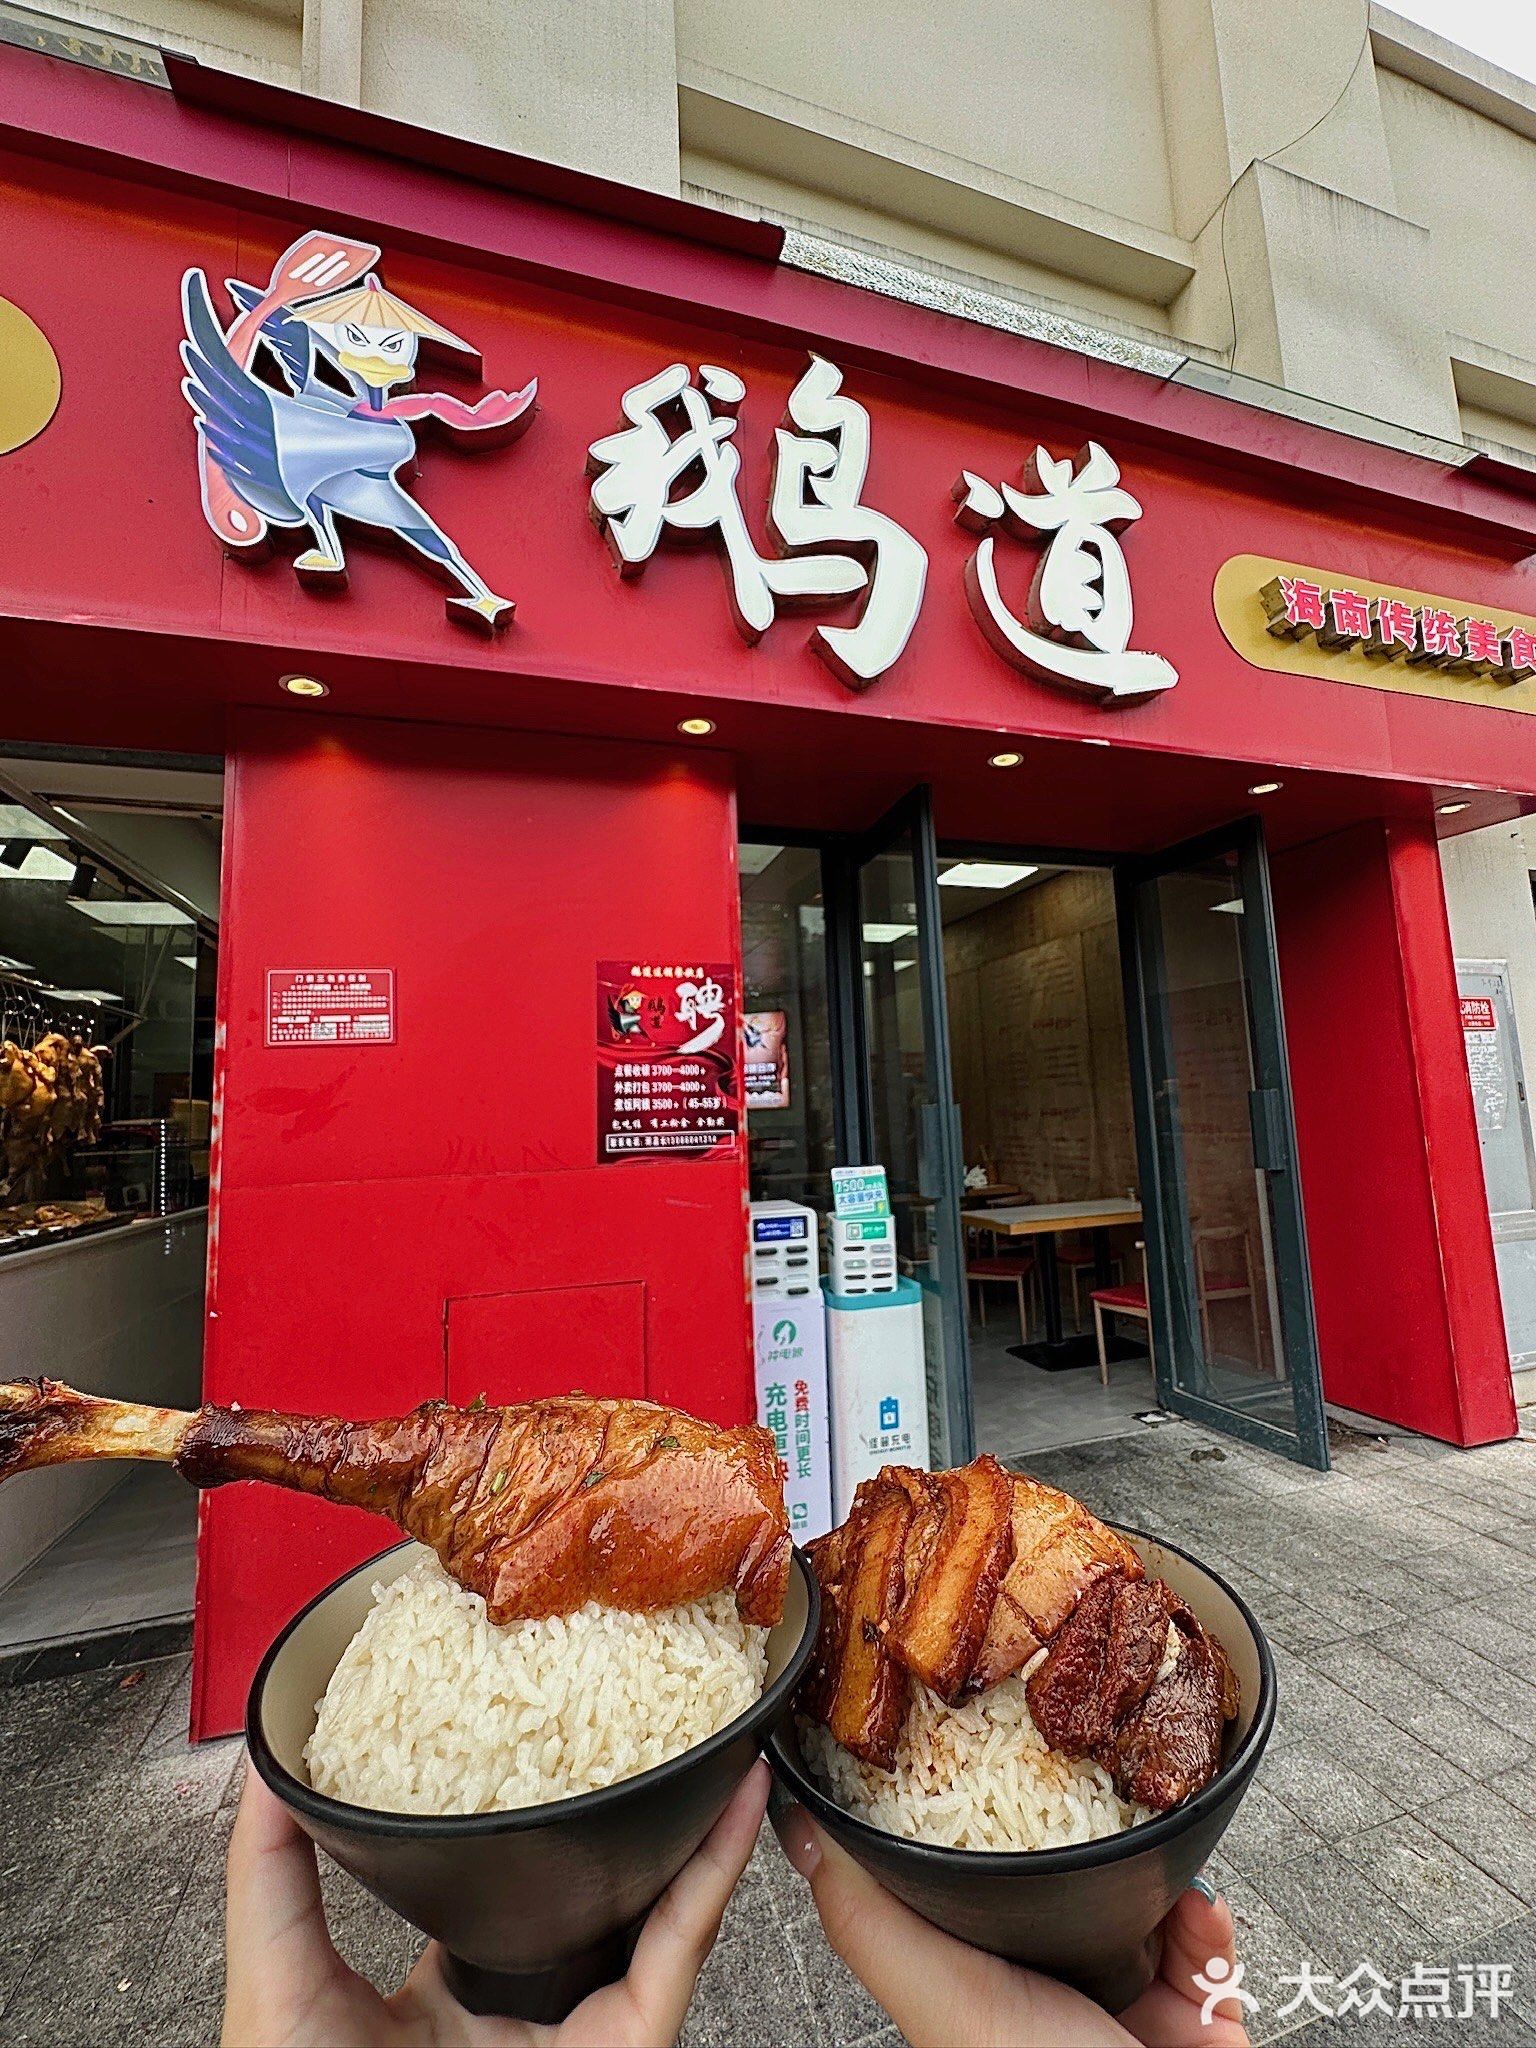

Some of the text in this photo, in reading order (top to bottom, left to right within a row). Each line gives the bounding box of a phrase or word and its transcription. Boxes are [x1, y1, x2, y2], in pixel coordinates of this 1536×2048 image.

[588, 352, 1180, 696] 鹅道
[1279, 576, 1536, 669] 海南传统美食
[674, 976, 727, 1055] 聘
